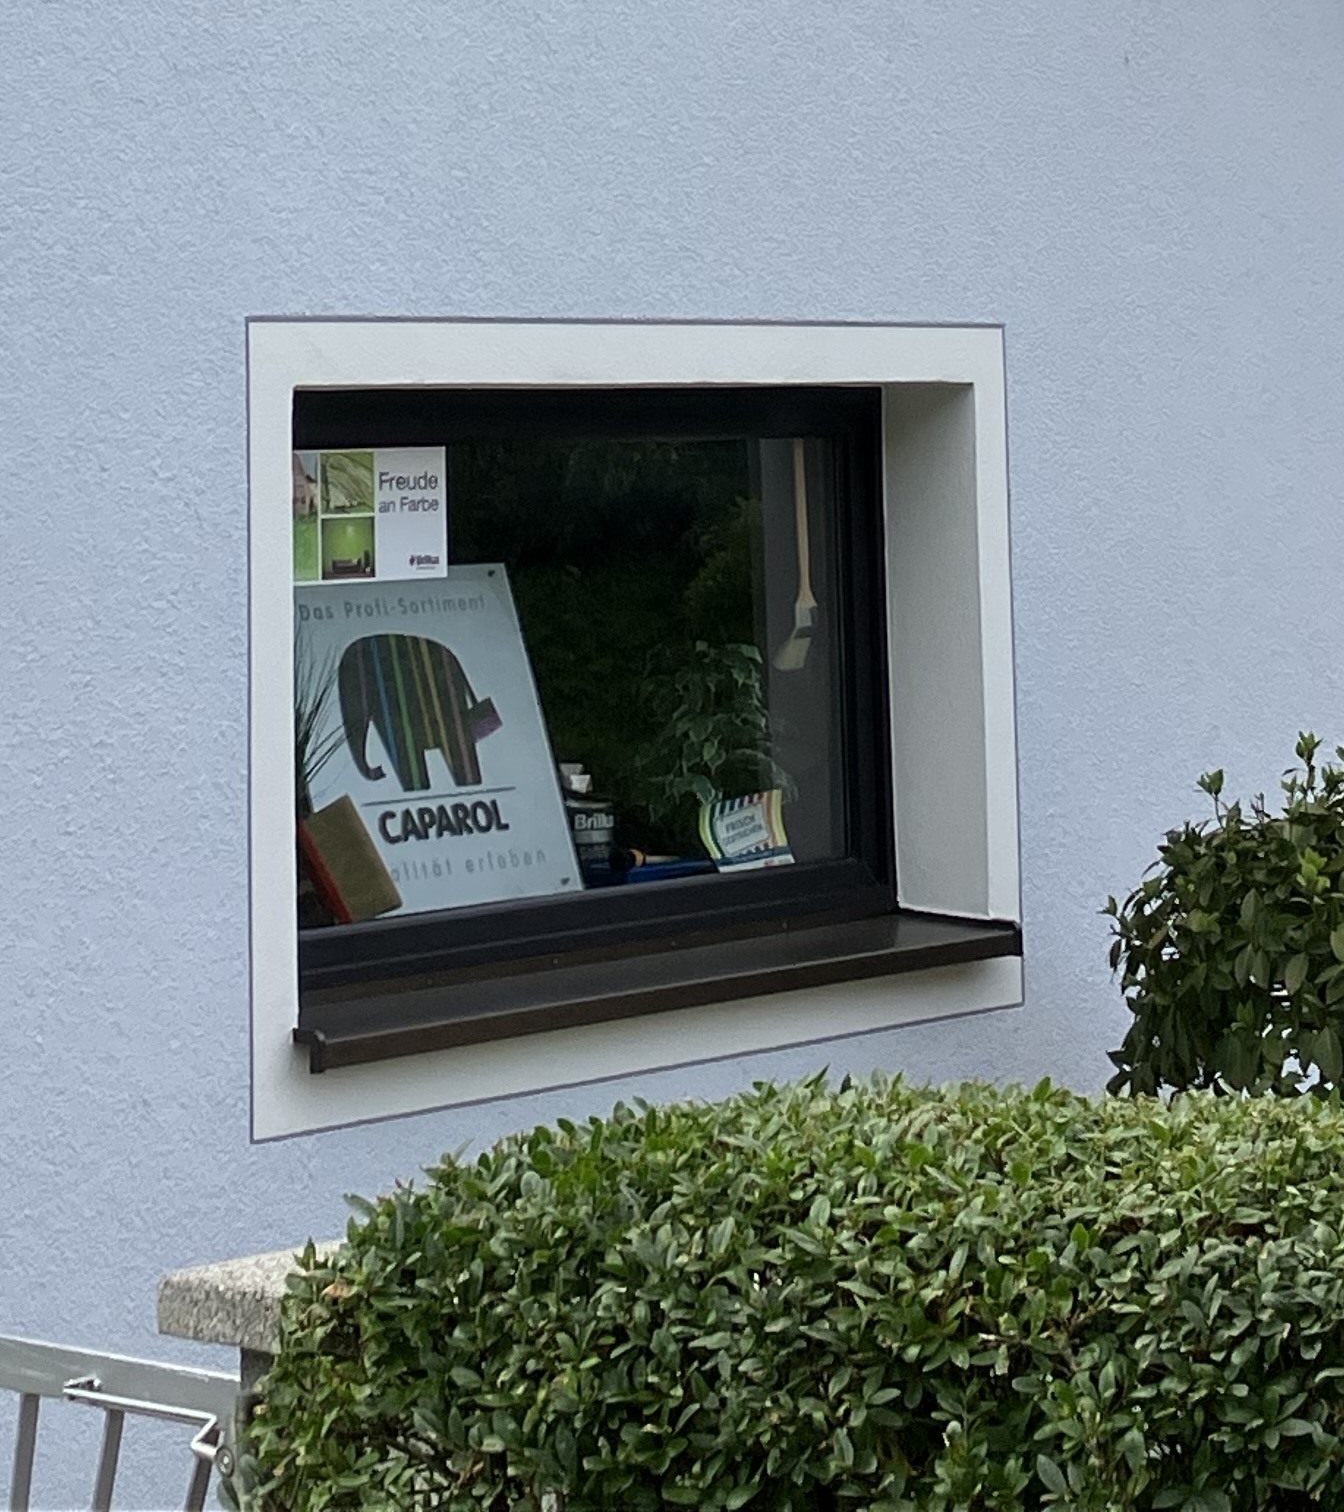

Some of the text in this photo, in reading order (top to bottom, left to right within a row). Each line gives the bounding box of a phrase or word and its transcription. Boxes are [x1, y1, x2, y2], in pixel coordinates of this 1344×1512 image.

[378, 470, 439, 492] Freude
[378, 496, 439, 513] an Farbe
[299, 594, 486, 622] Das Profi-Sortiment
[378, 799, 510, 844] CAPAROL
[574, 812, 615, 830] Brillu
[391, 857, 453, 883] alität
[465, 847, 547, 873] erleben
